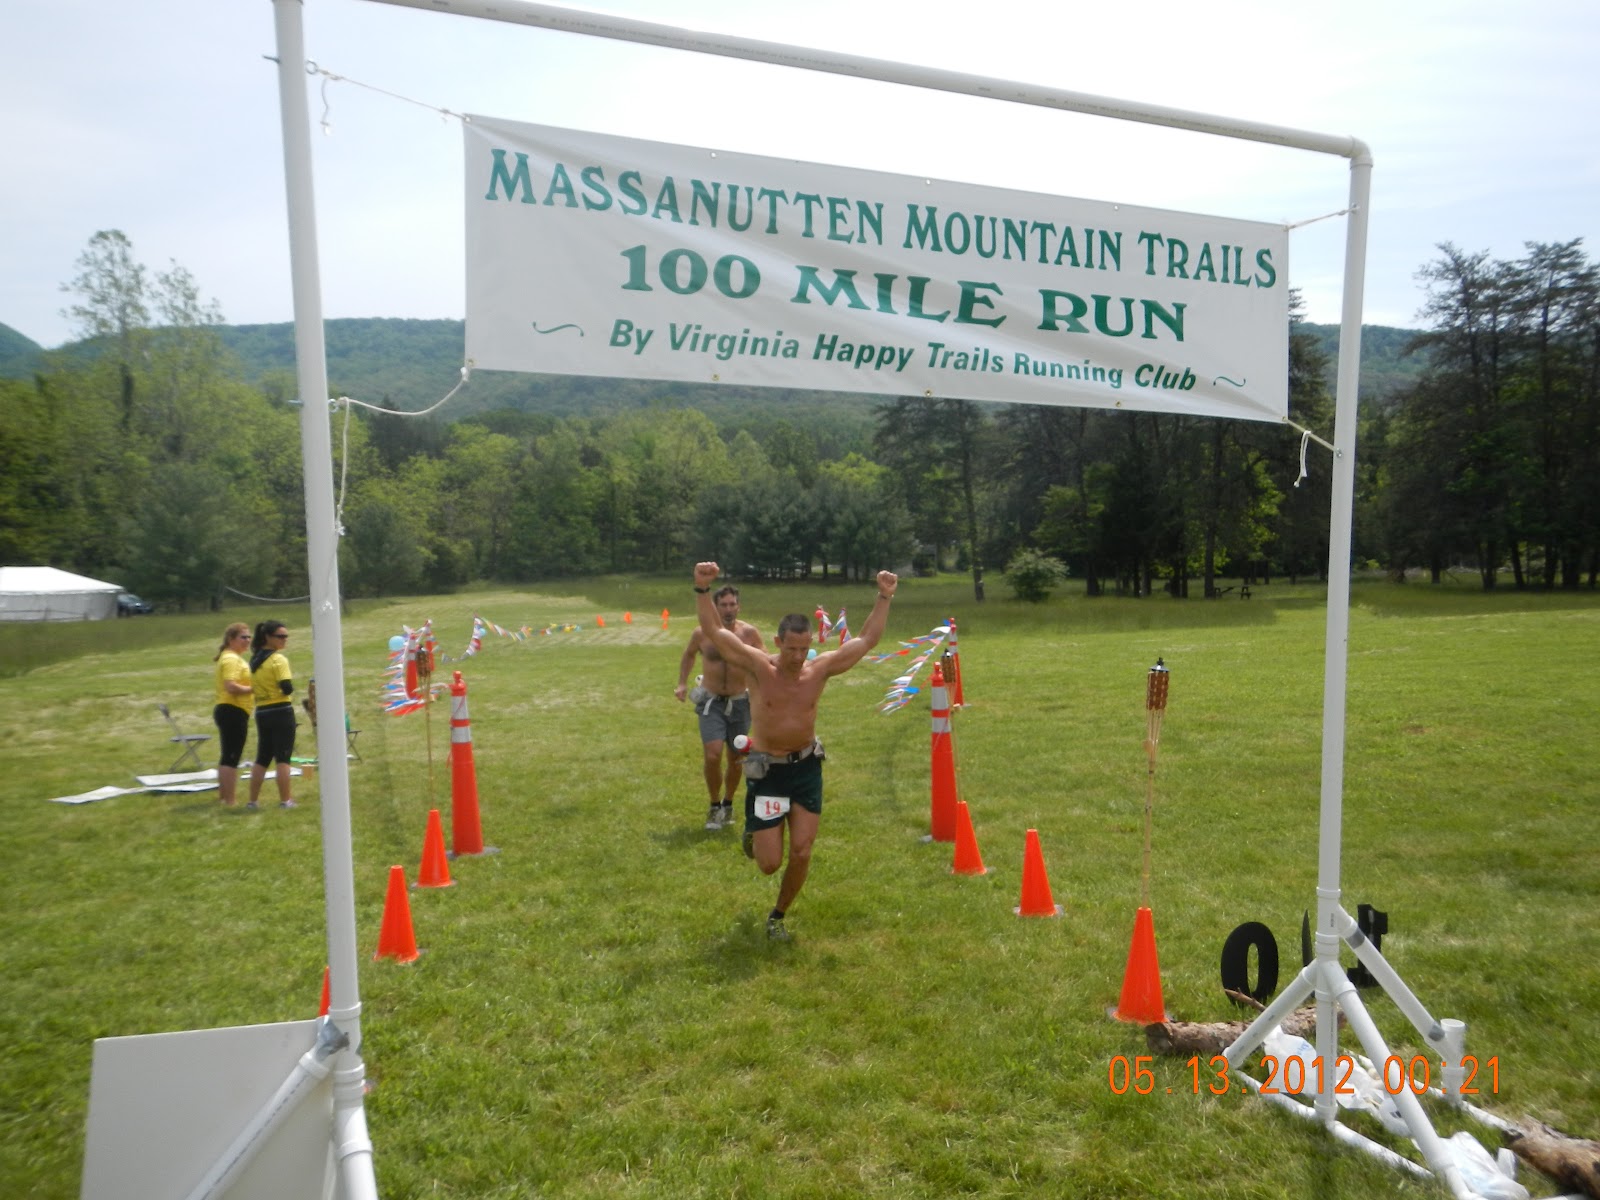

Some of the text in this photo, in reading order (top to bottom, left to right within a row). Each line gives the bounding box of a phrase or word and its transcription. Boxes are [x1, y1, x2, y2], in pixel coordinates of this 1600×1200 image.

[485, 148, 1277, 289] MASSANUTTEN MOUNTAIN TRAILS
[621, 245, 1187, 342] 100 MILE RUN
[610, 319, 1197, 391] By Virginia Happy Trails Running Club
[765, 800, 781, 815] 19
